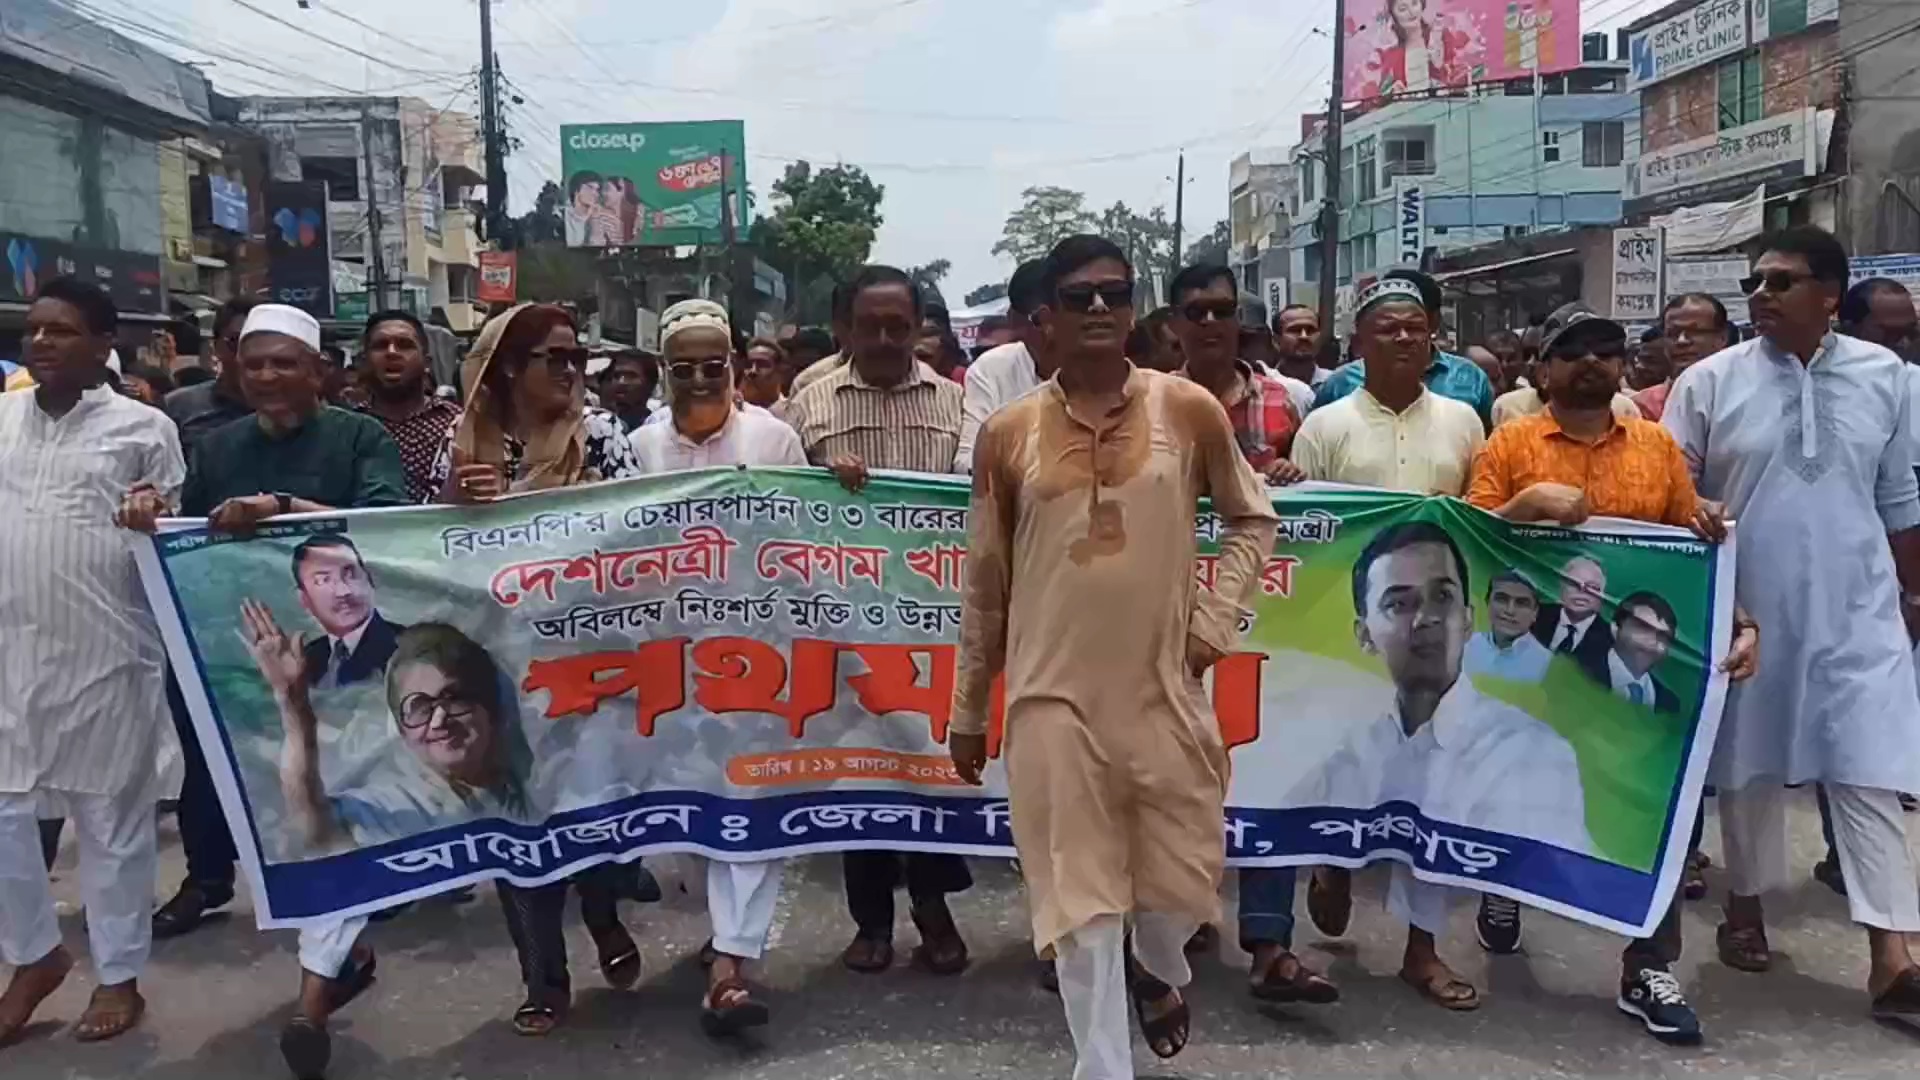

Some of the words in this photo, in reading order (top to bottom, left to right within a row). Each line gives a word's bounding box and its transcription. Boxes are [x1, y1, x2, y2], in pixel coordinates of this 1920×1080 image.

[1654, 17, 1689, 49] প্রাইম
[1694, 1, 1742, 36] ক্লিনিক
[1656, 46, 1694, 68] PRIME
[1696, 25, 1742, 53] CLINIC
[569, 131, 646, 153] closeup
[1620, 231, 1657, 263] প্রাইম
[623, 488, 799, 528] চেয়ারপার্সন
[808, 500, 832, 523] ও
[840, 504, 863, 526] ৩
[875, 503, 967, 532] বারের
[490, 525, 738, 606] দেশনেত্রী
[757, 537, 889, 592] বেগম
[533, 597, 666, 640] অবিলম্বে
[677, 589, 777, 624] নিঃশর্ত
[785, 595, 850, 630] মুক্তি
[862, 605, 885, 626] ও
[744, 759, 792, 777] তারিখ
[812, 758, 837, 772] ১৯
[375, 805, 702, 873] আয়োজনে
[779, 803, 958, 835] জেলা
